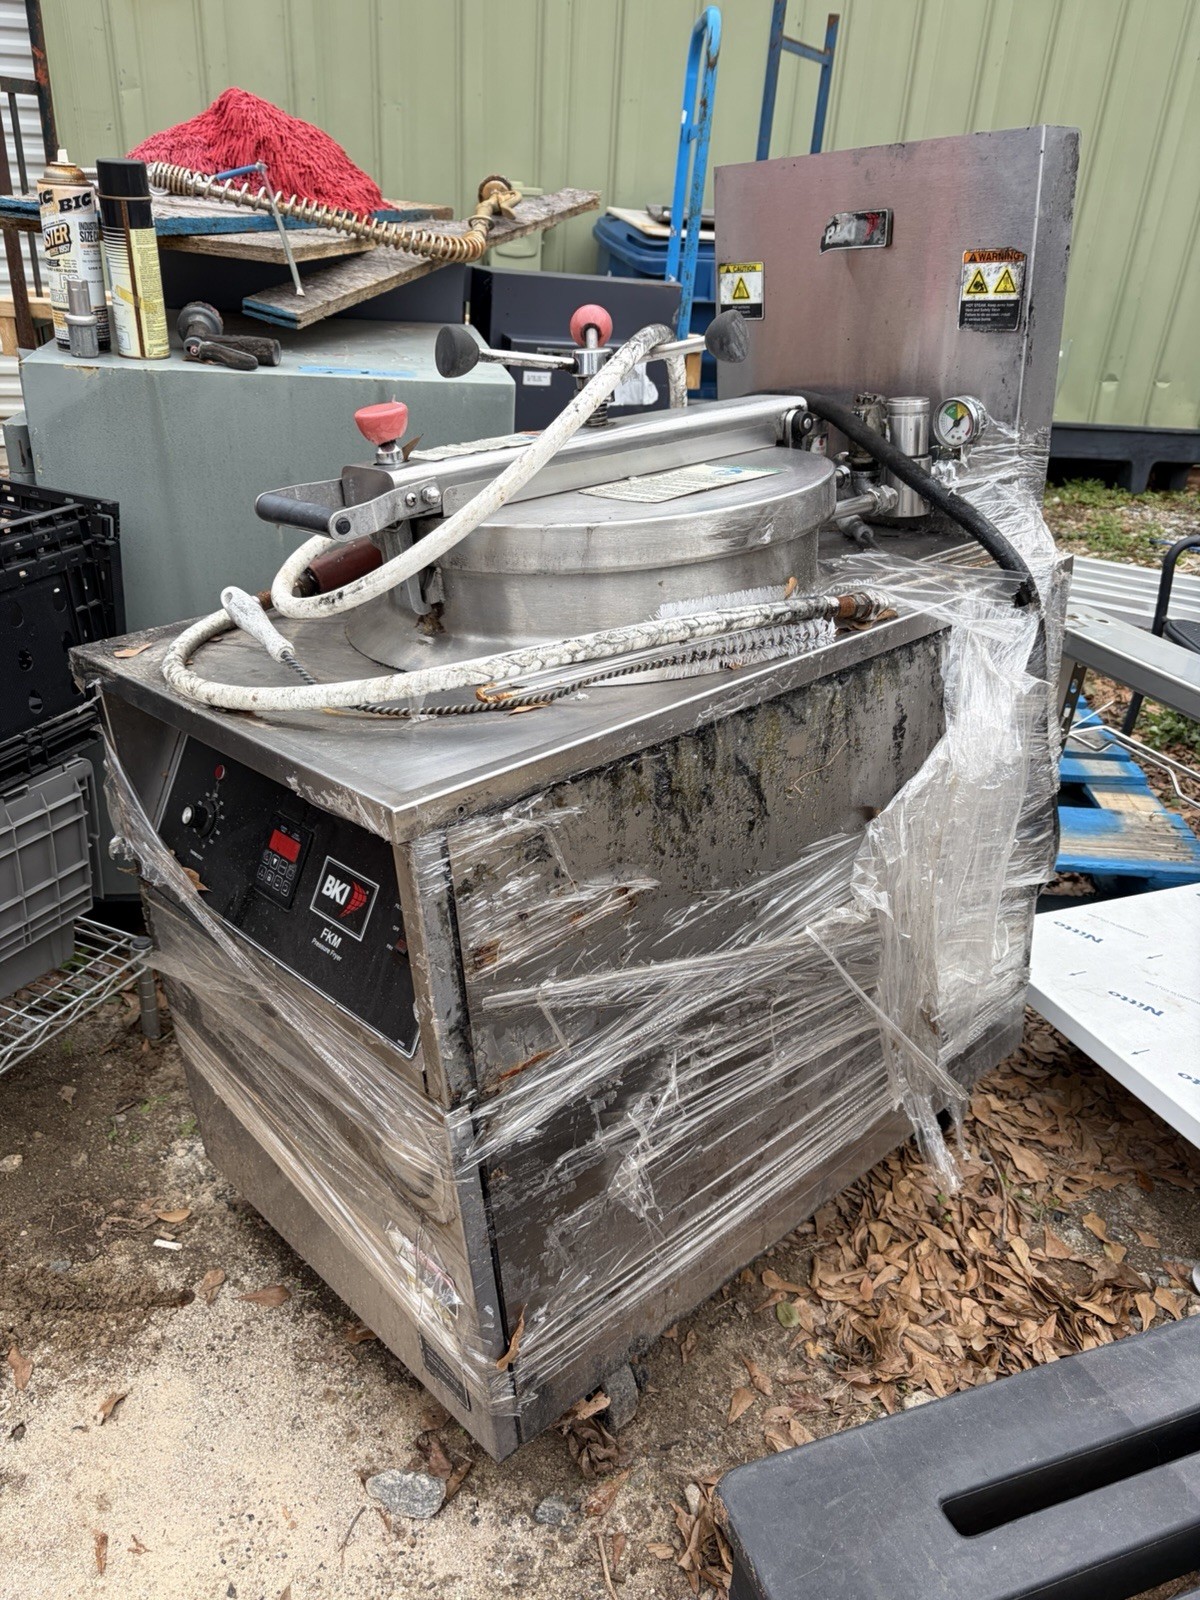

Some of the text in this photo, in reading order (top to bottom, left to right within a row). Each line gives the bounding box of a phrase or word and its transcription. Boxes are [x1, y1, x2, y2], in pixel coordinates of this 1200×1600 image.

[44, 224, 69, 248] STER
[732, 264, 757, 272] CAUTION
[978, 251, 1021, 262] WARNING
[321, 874, 351, 906] BKI
[320, 927, 343, 949] FKM
[1053, 920, 1104, 944] Nitto
[311, 937, 343, 962] Pressure Fryer
[1107, 990, 1165, 1017] Nitto
